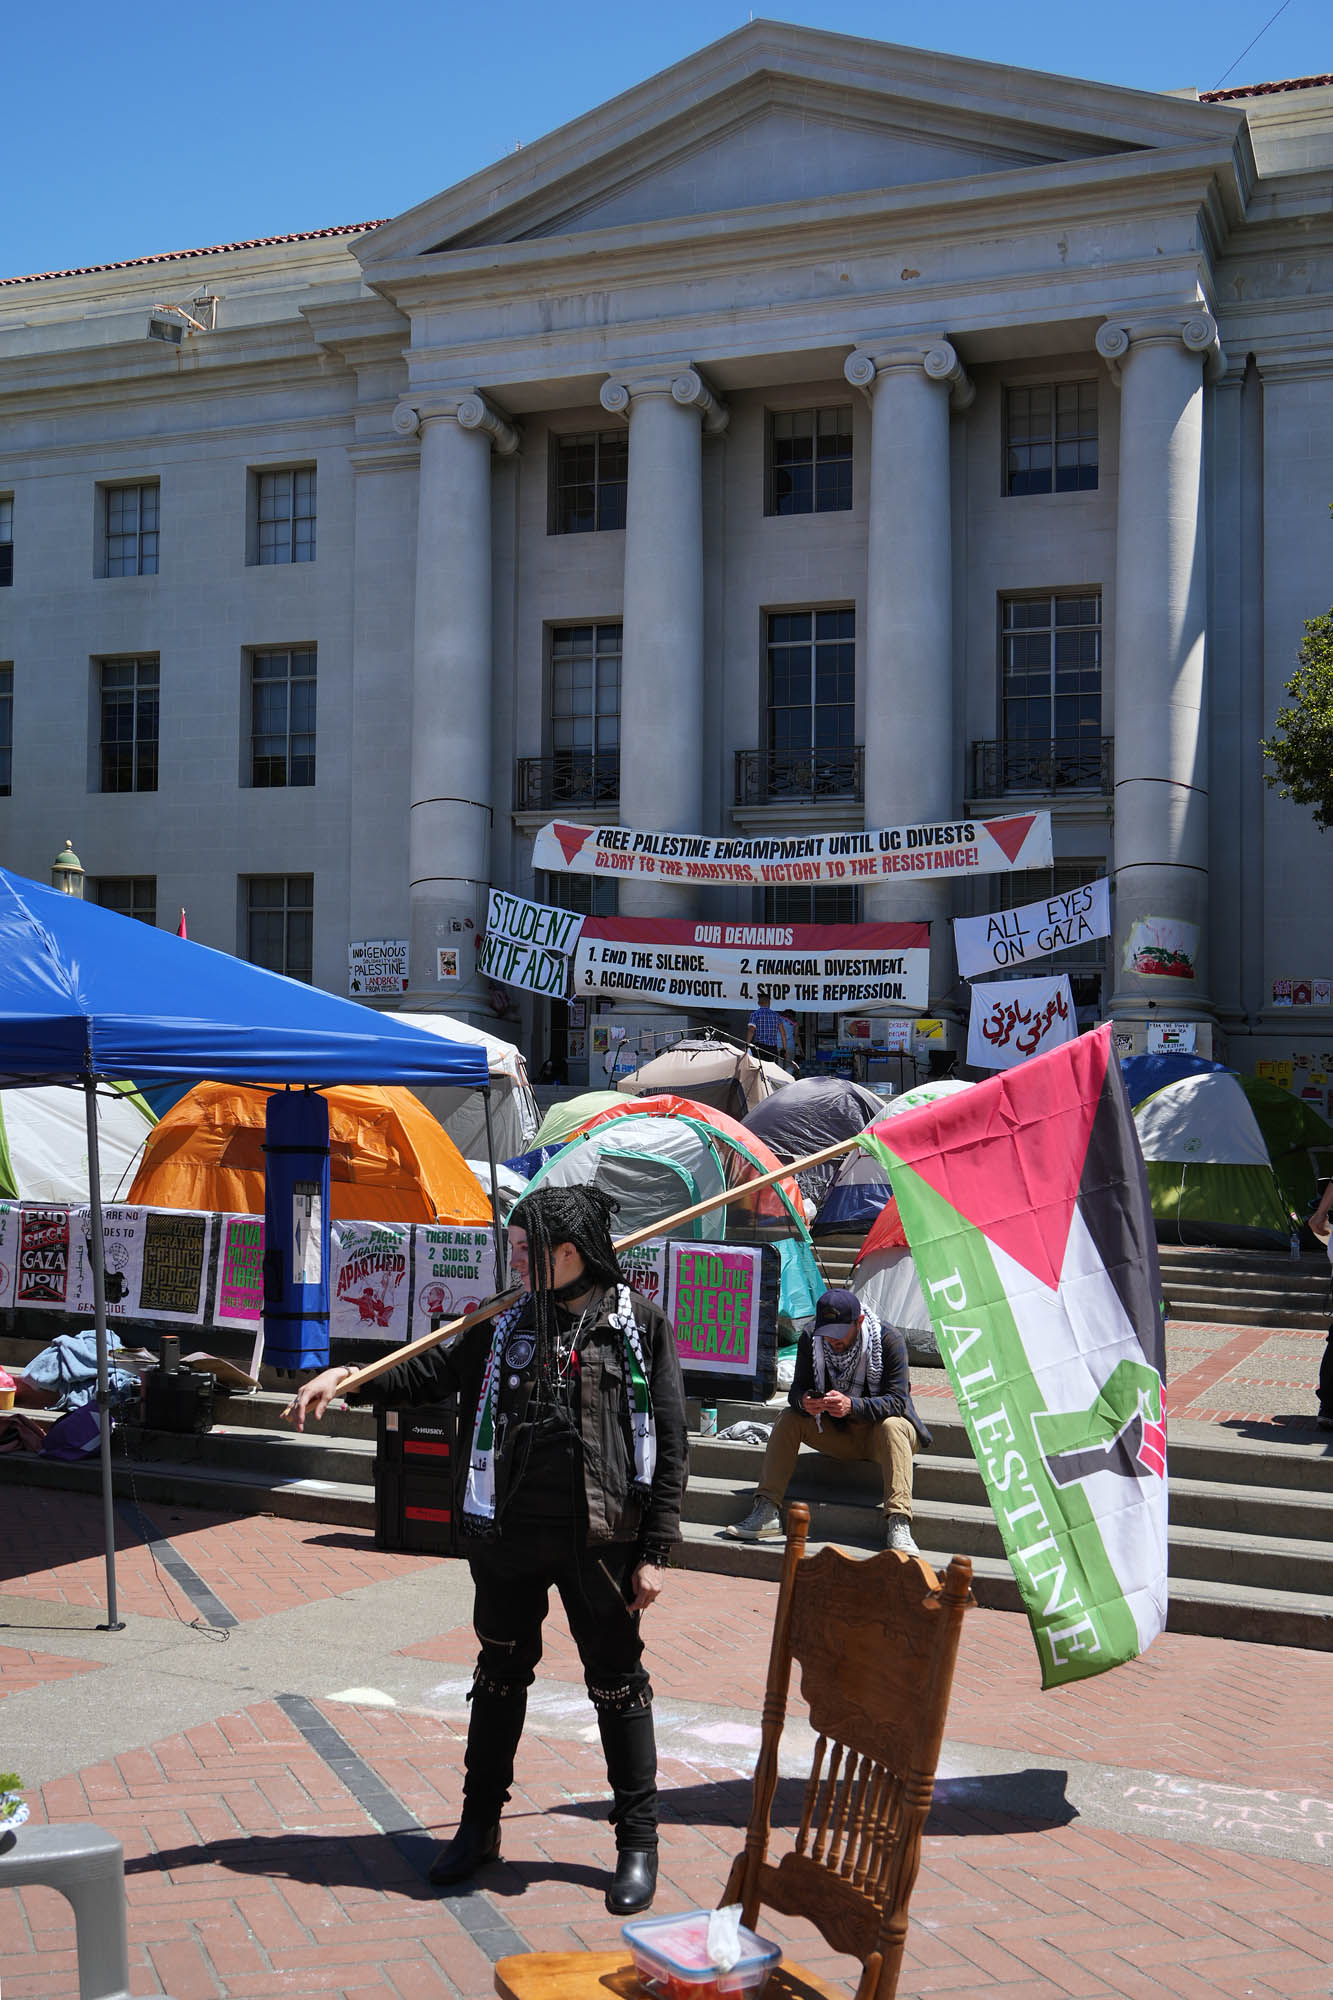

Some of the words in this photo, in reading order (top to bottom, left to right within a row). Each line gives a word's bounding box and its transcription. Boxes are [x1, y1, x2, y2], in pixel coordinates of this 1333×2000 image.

[596, 829, 631, 851] FREE
[632, 833, 711, 858] PALESTINE
[713, 838, 825, 860] ENCAMPMENT
[828, 834, 874, 855] UNTIL
[879, 830, 902, 852] UC
[906, 823, 976, 849] DIVESTS
[594, 851, 636, 872] GLORY
[639, 856, 656, 873] TO
[658, 859, 684, 876] THE
[685, 862, 759, 884] MARTYRS,
[760, 862, 822, 882] VICTORY
[825, 861, 846, 879] TO
[849, 857, 878, 877] THE
[882, 847, 980, 874] RESISTANCE!
[489, 892, 581, 949] STUDENT
[987, 911, 1031, 942] ALL
[1046, 885, 1093, 925] EYES
[694, 925, 722, 944] OUR
[725, 926, 794, 946] DEMANDS
[993, 937, 1025, 965] ON
[1037, 914, 1094, 951] GAZA
[352, 946, 407, 958] INDIGENOUS
[588, 946, 598, 962] 1.
[601, 947, 627, 965] END
[631, 951, 653, 969] THE
[655, 953, 710, 973] SILENCE.
[354, 961, 407, 976] PALESTINE
[479, 935, 565, 996] INTIFADA
[740, 958, 753, 974] 2.
[756, 958, 821, 976] FINANCIAL
[824, 957, 908, 976] DIVESTMENT.
[364, 976, 400, 985] LANDBACK
[584, 969, 597, 986] 3.
[600, 970, 667, 992] ACADEMIC
[669, 978, 728, 998] BOYCOTT.
[740, 982, 754, 999] 4.
[757, 983, 791, 1001] STOP
[794, 984, 819, 1001] THE
[823, 982, 907, 1001] REPRESSION.
[24, 1211, 67, 1226] END
[106, 1210, 123, 1220] ARE
[125, 1211, 139, 1221] NO
[24, 1226, 67, 1249] SIEGE
[103, 1227, 121, 1238] DES
[123, 1229, 135, 1238] TO
[230, 1223, 261, 1248] VIVA
[368, 1230, 406, 1245] FIGHT
[426, 1231, 451, 1245] THERE
[454, 1231, 473, 1246] ARE
[474, 1233, 488, 1246] NO
[22, 1250, 67, 1271] GAZA
[227, 1246, 265, 1268] PALEST
[348, 1243, 400, 1262] AGAINST
[428, 1247, 436, 1260] 2
[442, 1248, 470, 1263] SIDES
[475, 1250, 482, 1263] 2
[224, 1265, 263, 1290] LIBRE
[336, 1253, 406, 1297] APARTHEID
[432, 1264, 480, 1280] GENOCIDE
[679, 1254, 724, 1288] END
[725, 1268, 750, 1290] THE
[21, 1272, 65, 1296] NOW
[677, 1288, 750, 1328] SIEGE
[677, 1323, 691, 1343] ON
[692, 1324, 746, 1357] GAZA
[926, 1266, 1101, 1667] PALESTINE
